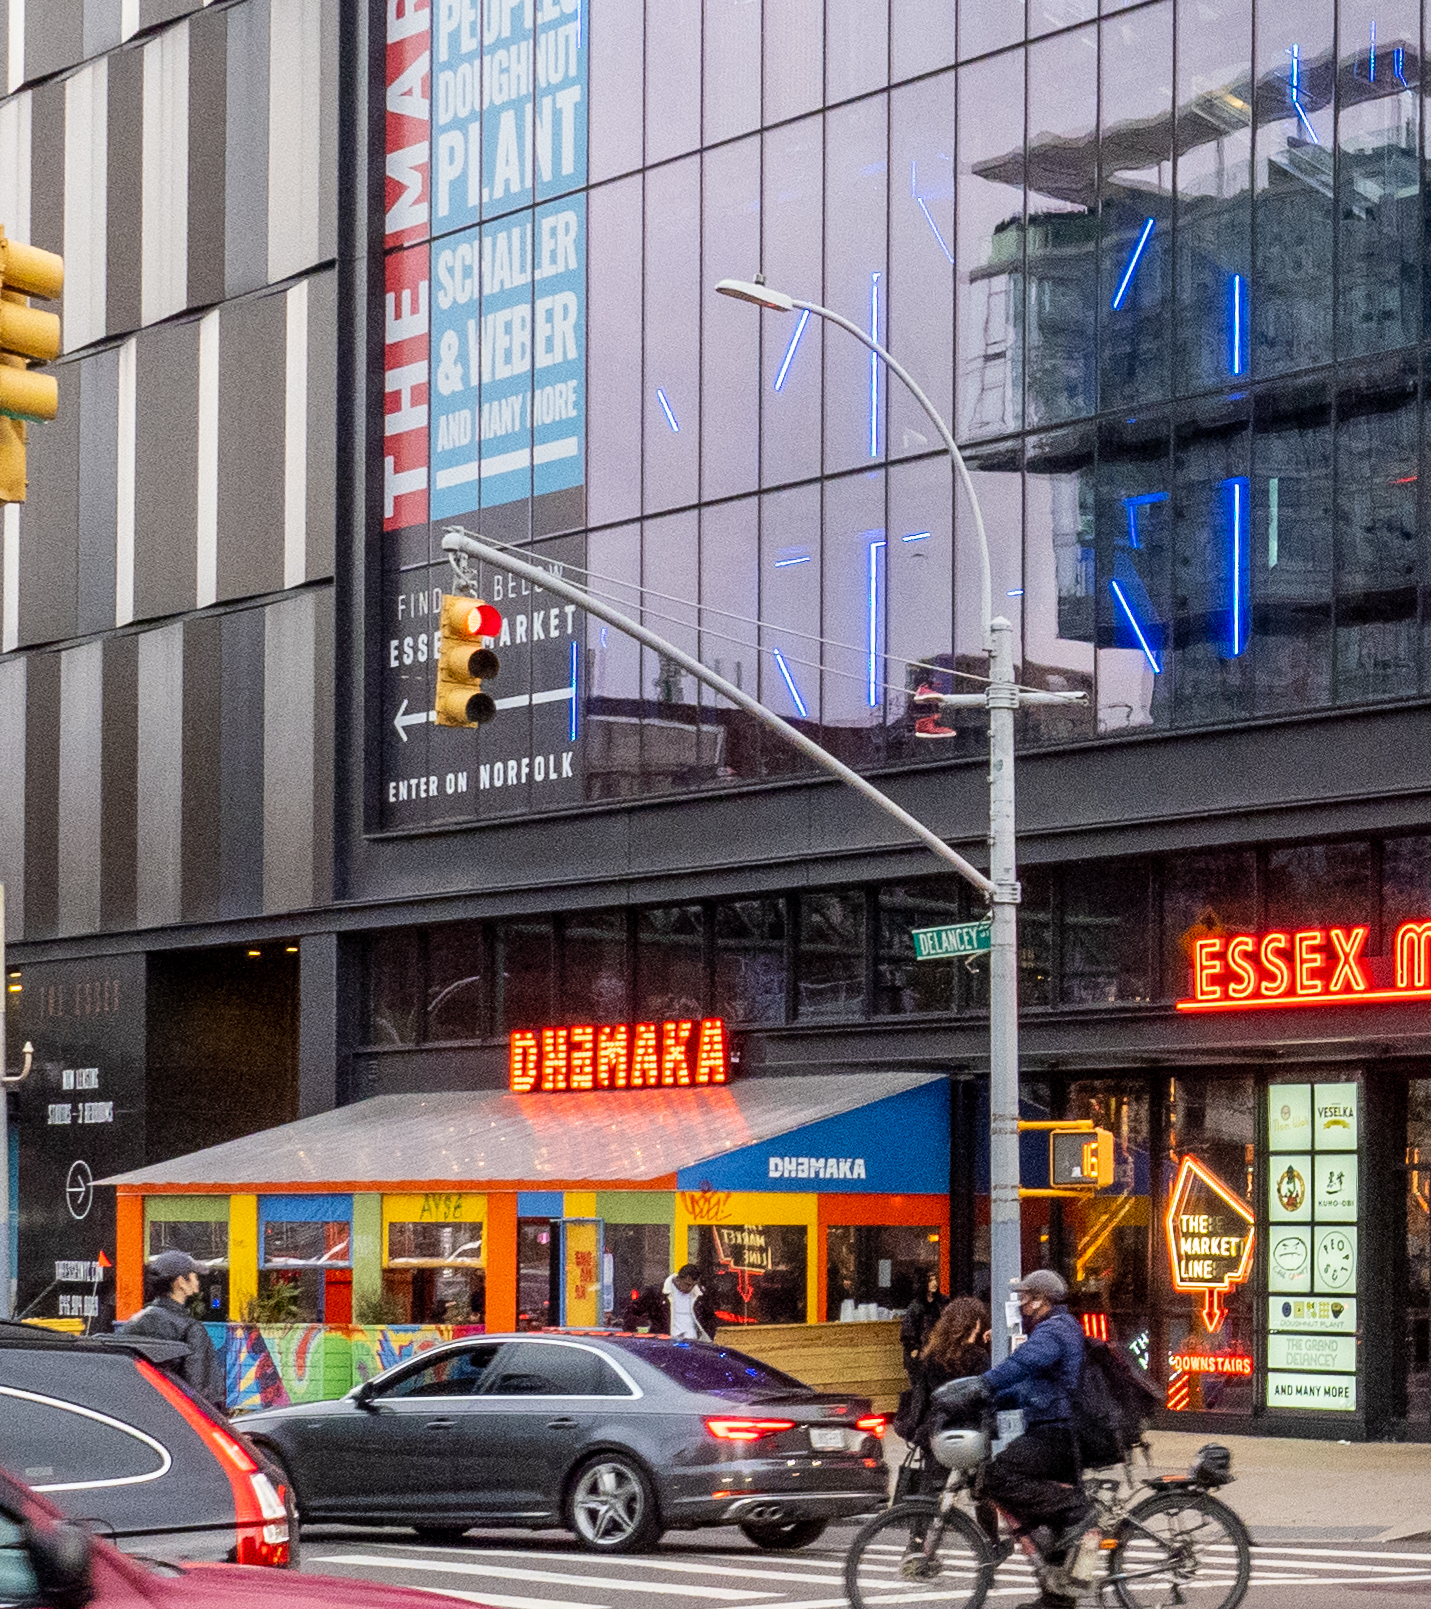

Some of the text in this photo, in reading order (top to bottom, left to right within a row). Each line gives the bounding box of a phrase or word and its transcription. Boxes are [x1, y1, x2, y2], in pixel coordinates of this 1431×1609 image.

[438, 20, 579, 127] DOUGHNUT
[437, 85, 581, 218] PLANT
[437, 210, 578, 310] SCHALLER
[436, 291, 578, 397] & WEBER
[384, 279, 429, 519] THE
[437, 379, 578, 453] AND MANY MORE
[398, 588, 442, 621] FIND
[390, 635, 442, 669] ESSE
[389, 751, 574, 803] ENTER ON NORFOLK
[920, 928, 978, 956] DELANCEY
[1194, 925, 1369, 1001] ESSEX
[1318, 1106, 1354, 1118] VESELKA
[1181, 1215, 1208, 1233] THE
[1181, 1237, 1239, 1256] MARKET
[1181, 1260, 1212, 1279] LINE
[1286, 1339, 1338, 1352] THE GRAND
[1286, 1352, 1337, 1367] DELANCEY
[1175, 1356, 1251, 1373] DOWNSTAIRS
[1274, 1384, 1350, 1398] AND MANY MORE
